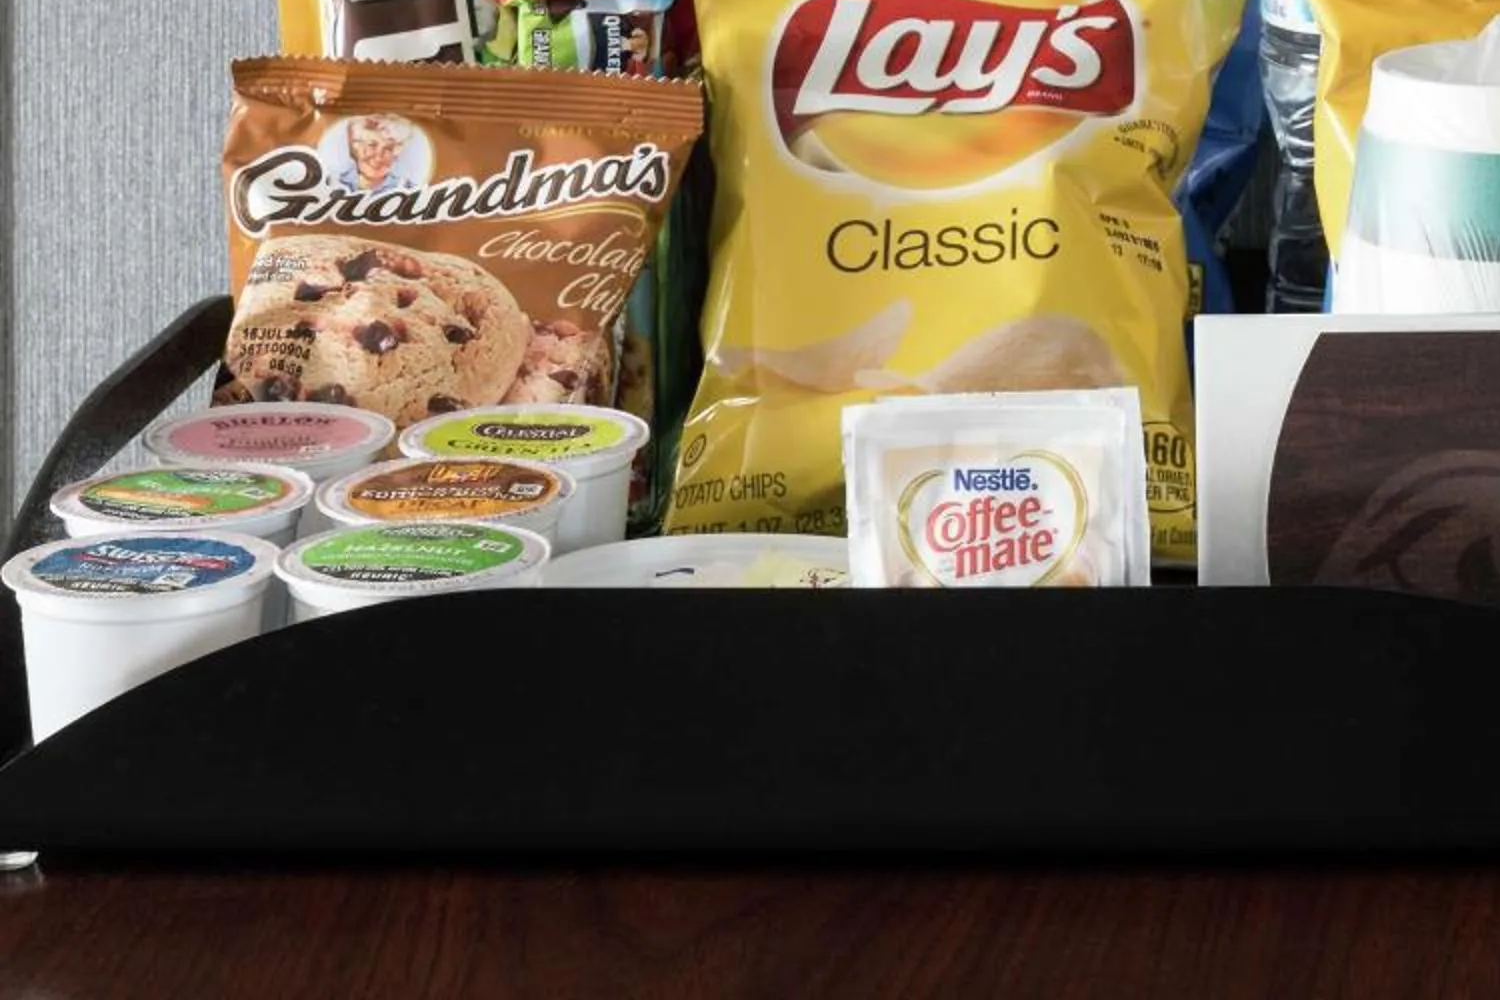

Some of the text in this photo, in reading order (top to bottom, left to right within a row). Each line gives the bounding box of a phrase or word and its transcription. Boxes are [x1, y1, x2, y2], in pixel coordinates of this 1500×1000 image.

[602, 14, 623, 75] QUAKE
[231, 142, 668, 235] Grandma's
[478, 229, 647, 277] Chocolate
[825, 208, 1060, 274] Classic
[729, 471, 787, 501] CHIPS
[955, 529, 1055, 579] mate
